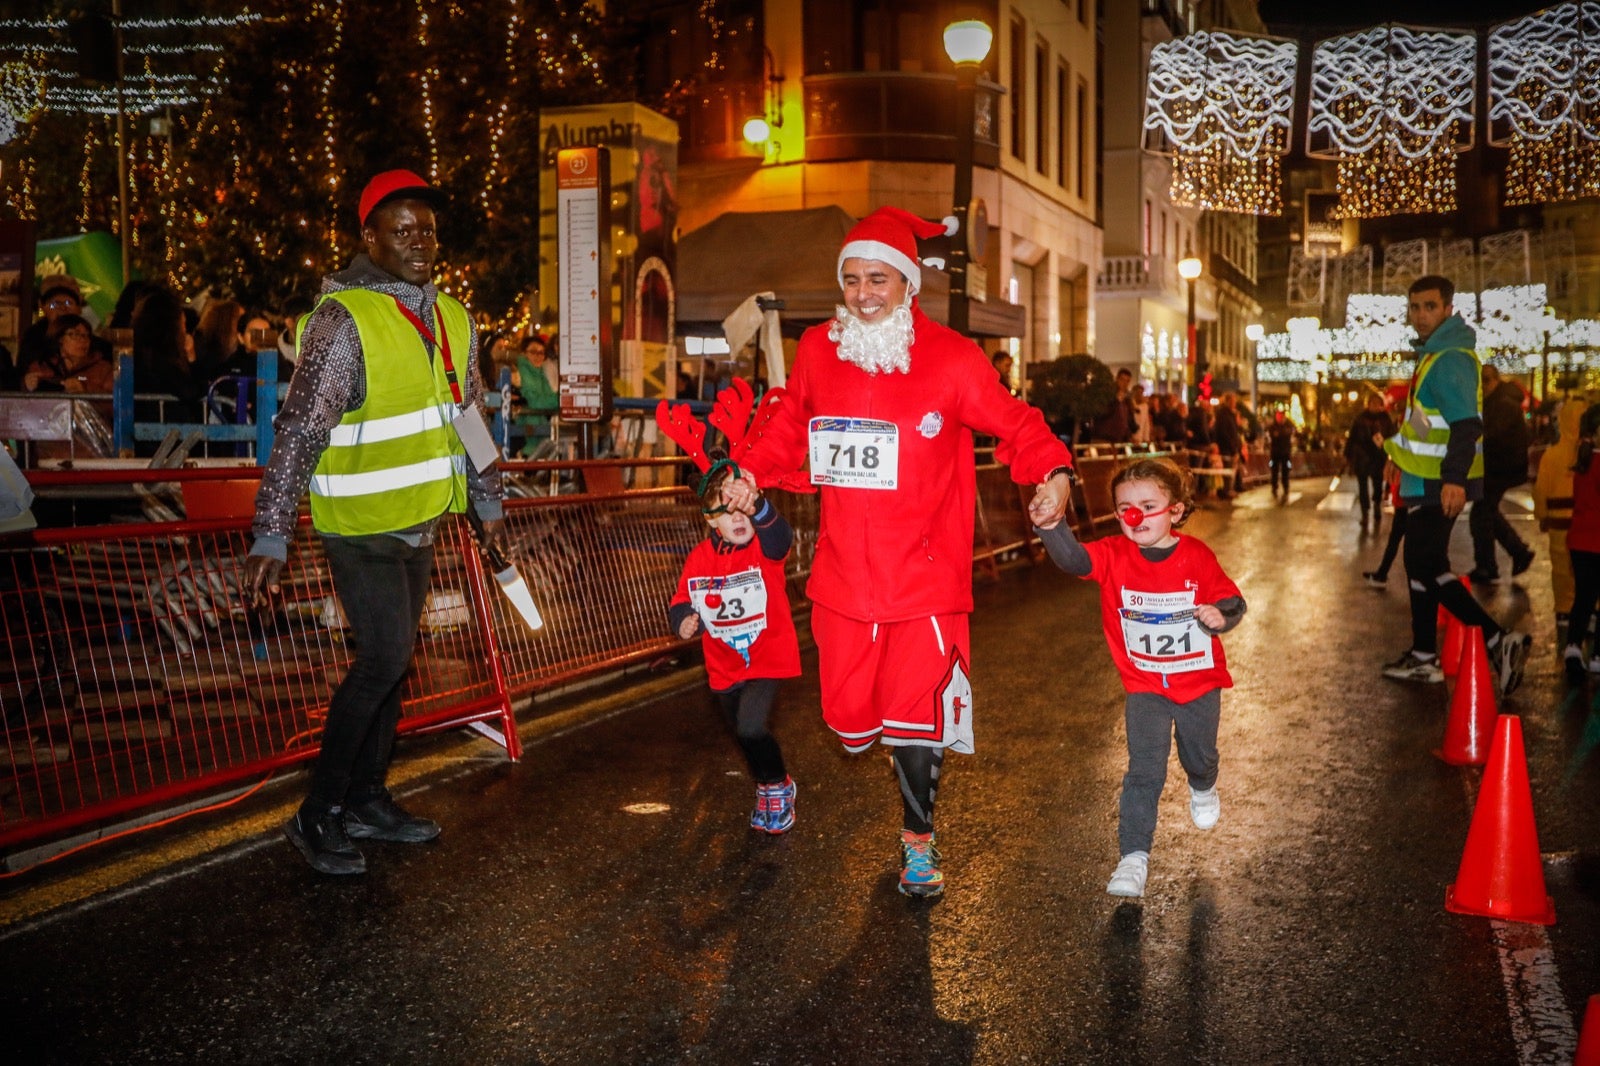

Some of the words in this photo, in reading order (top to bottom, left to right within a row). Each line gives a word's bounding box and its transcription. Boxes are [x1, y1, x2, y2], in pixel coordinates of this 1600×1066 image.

[573, 159, 584, 168] 21
[829, 443, 880, 469] 718
[717, 598, 746, 619] 23
[1130, 594, 1143, 606] 30
[1139, 632, 1192, 655] 121
